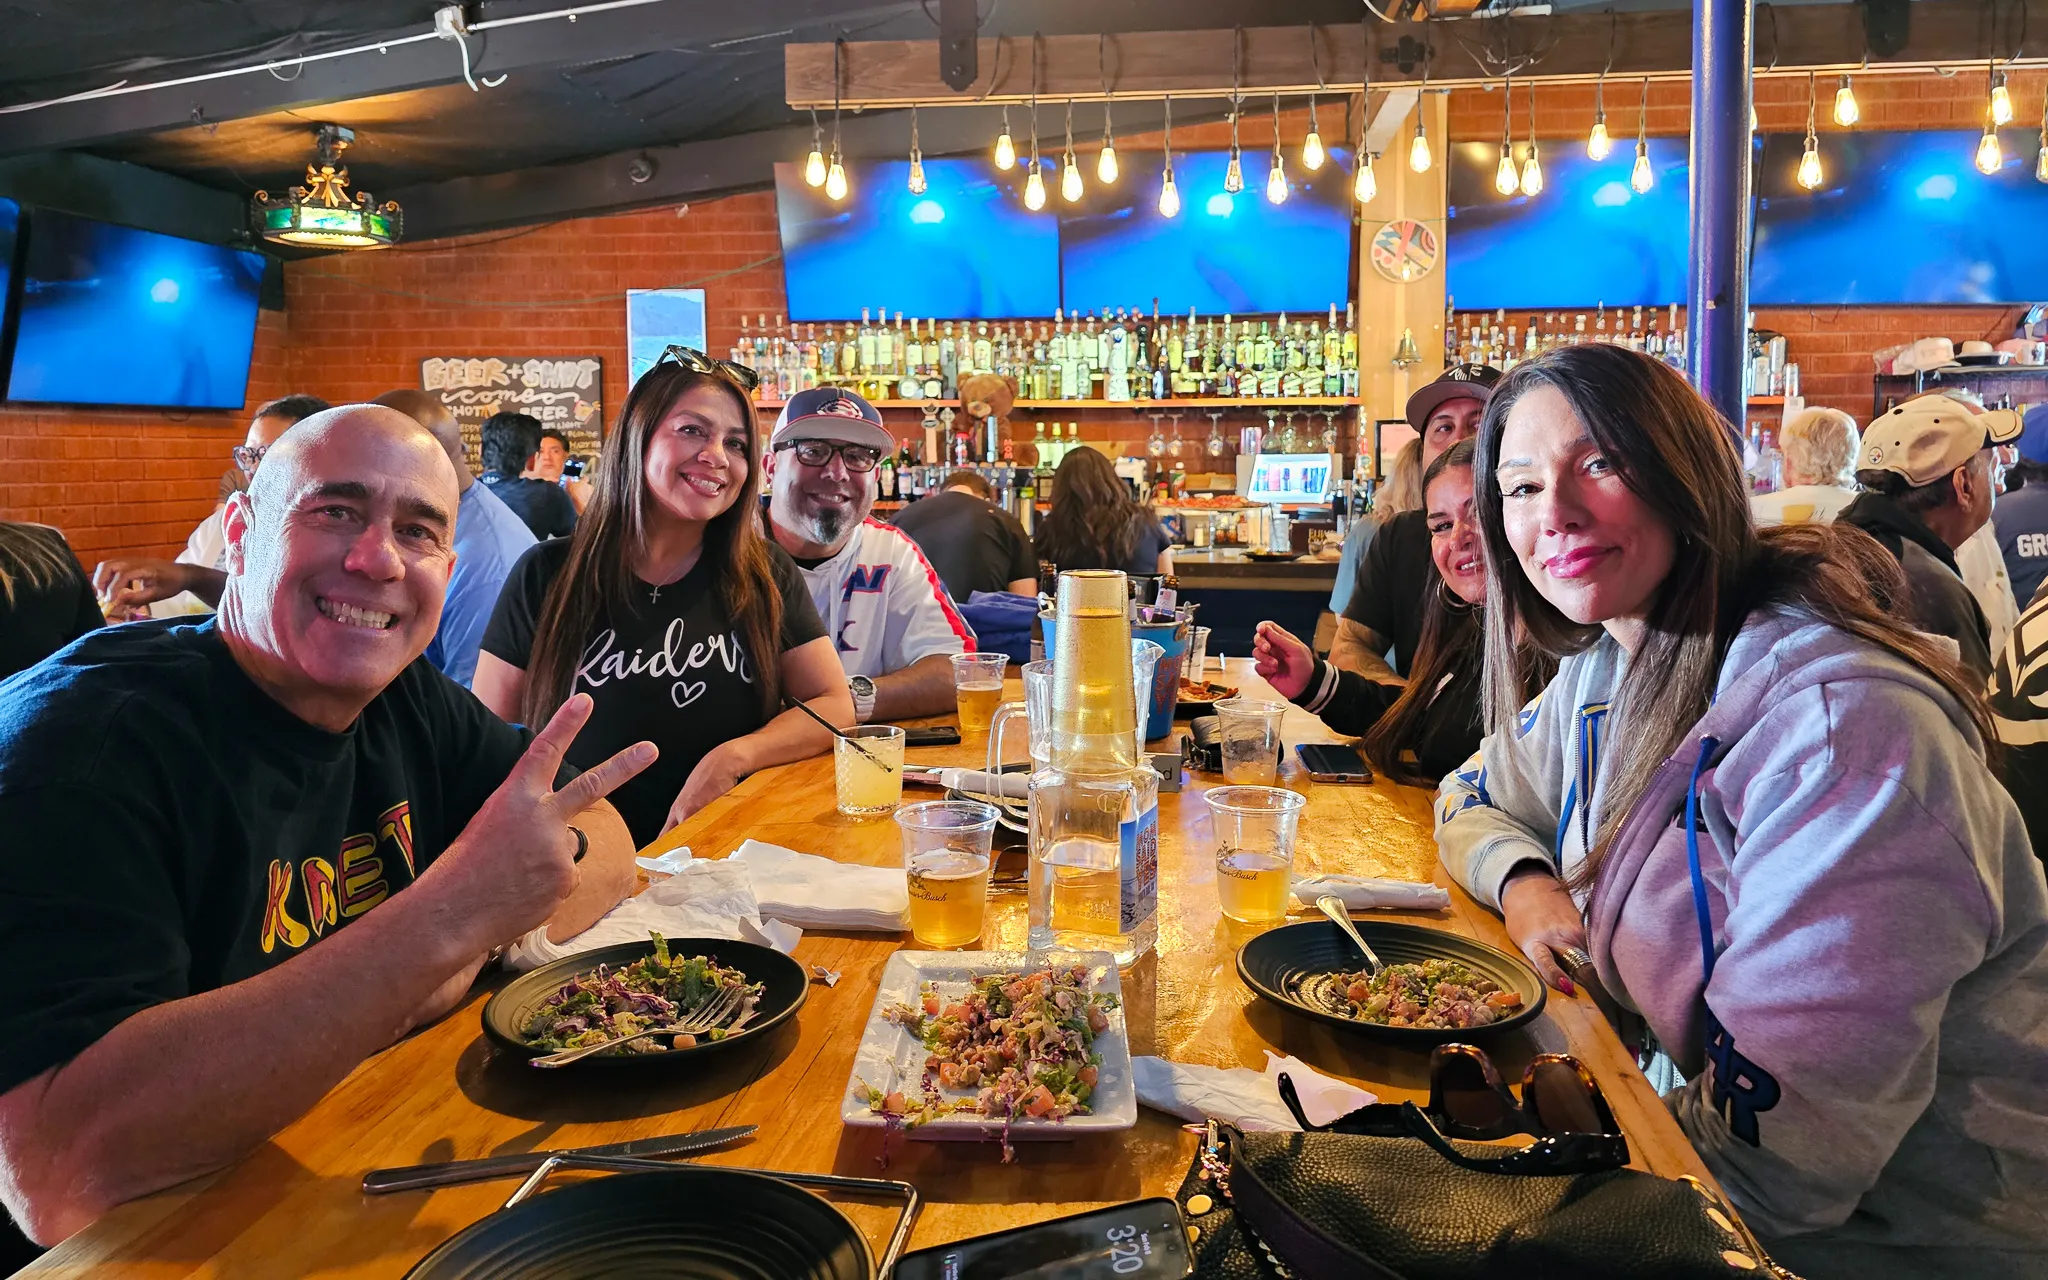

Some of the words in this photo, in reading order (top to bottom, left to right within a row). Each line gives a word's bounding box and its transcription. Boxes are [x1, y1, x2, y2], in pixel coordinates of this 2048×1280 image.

[2017, 533, 2048, 557] GR
[570, 617, 754, 698] Raiders
[1107, 1224, 1144, 1274] 3:20
